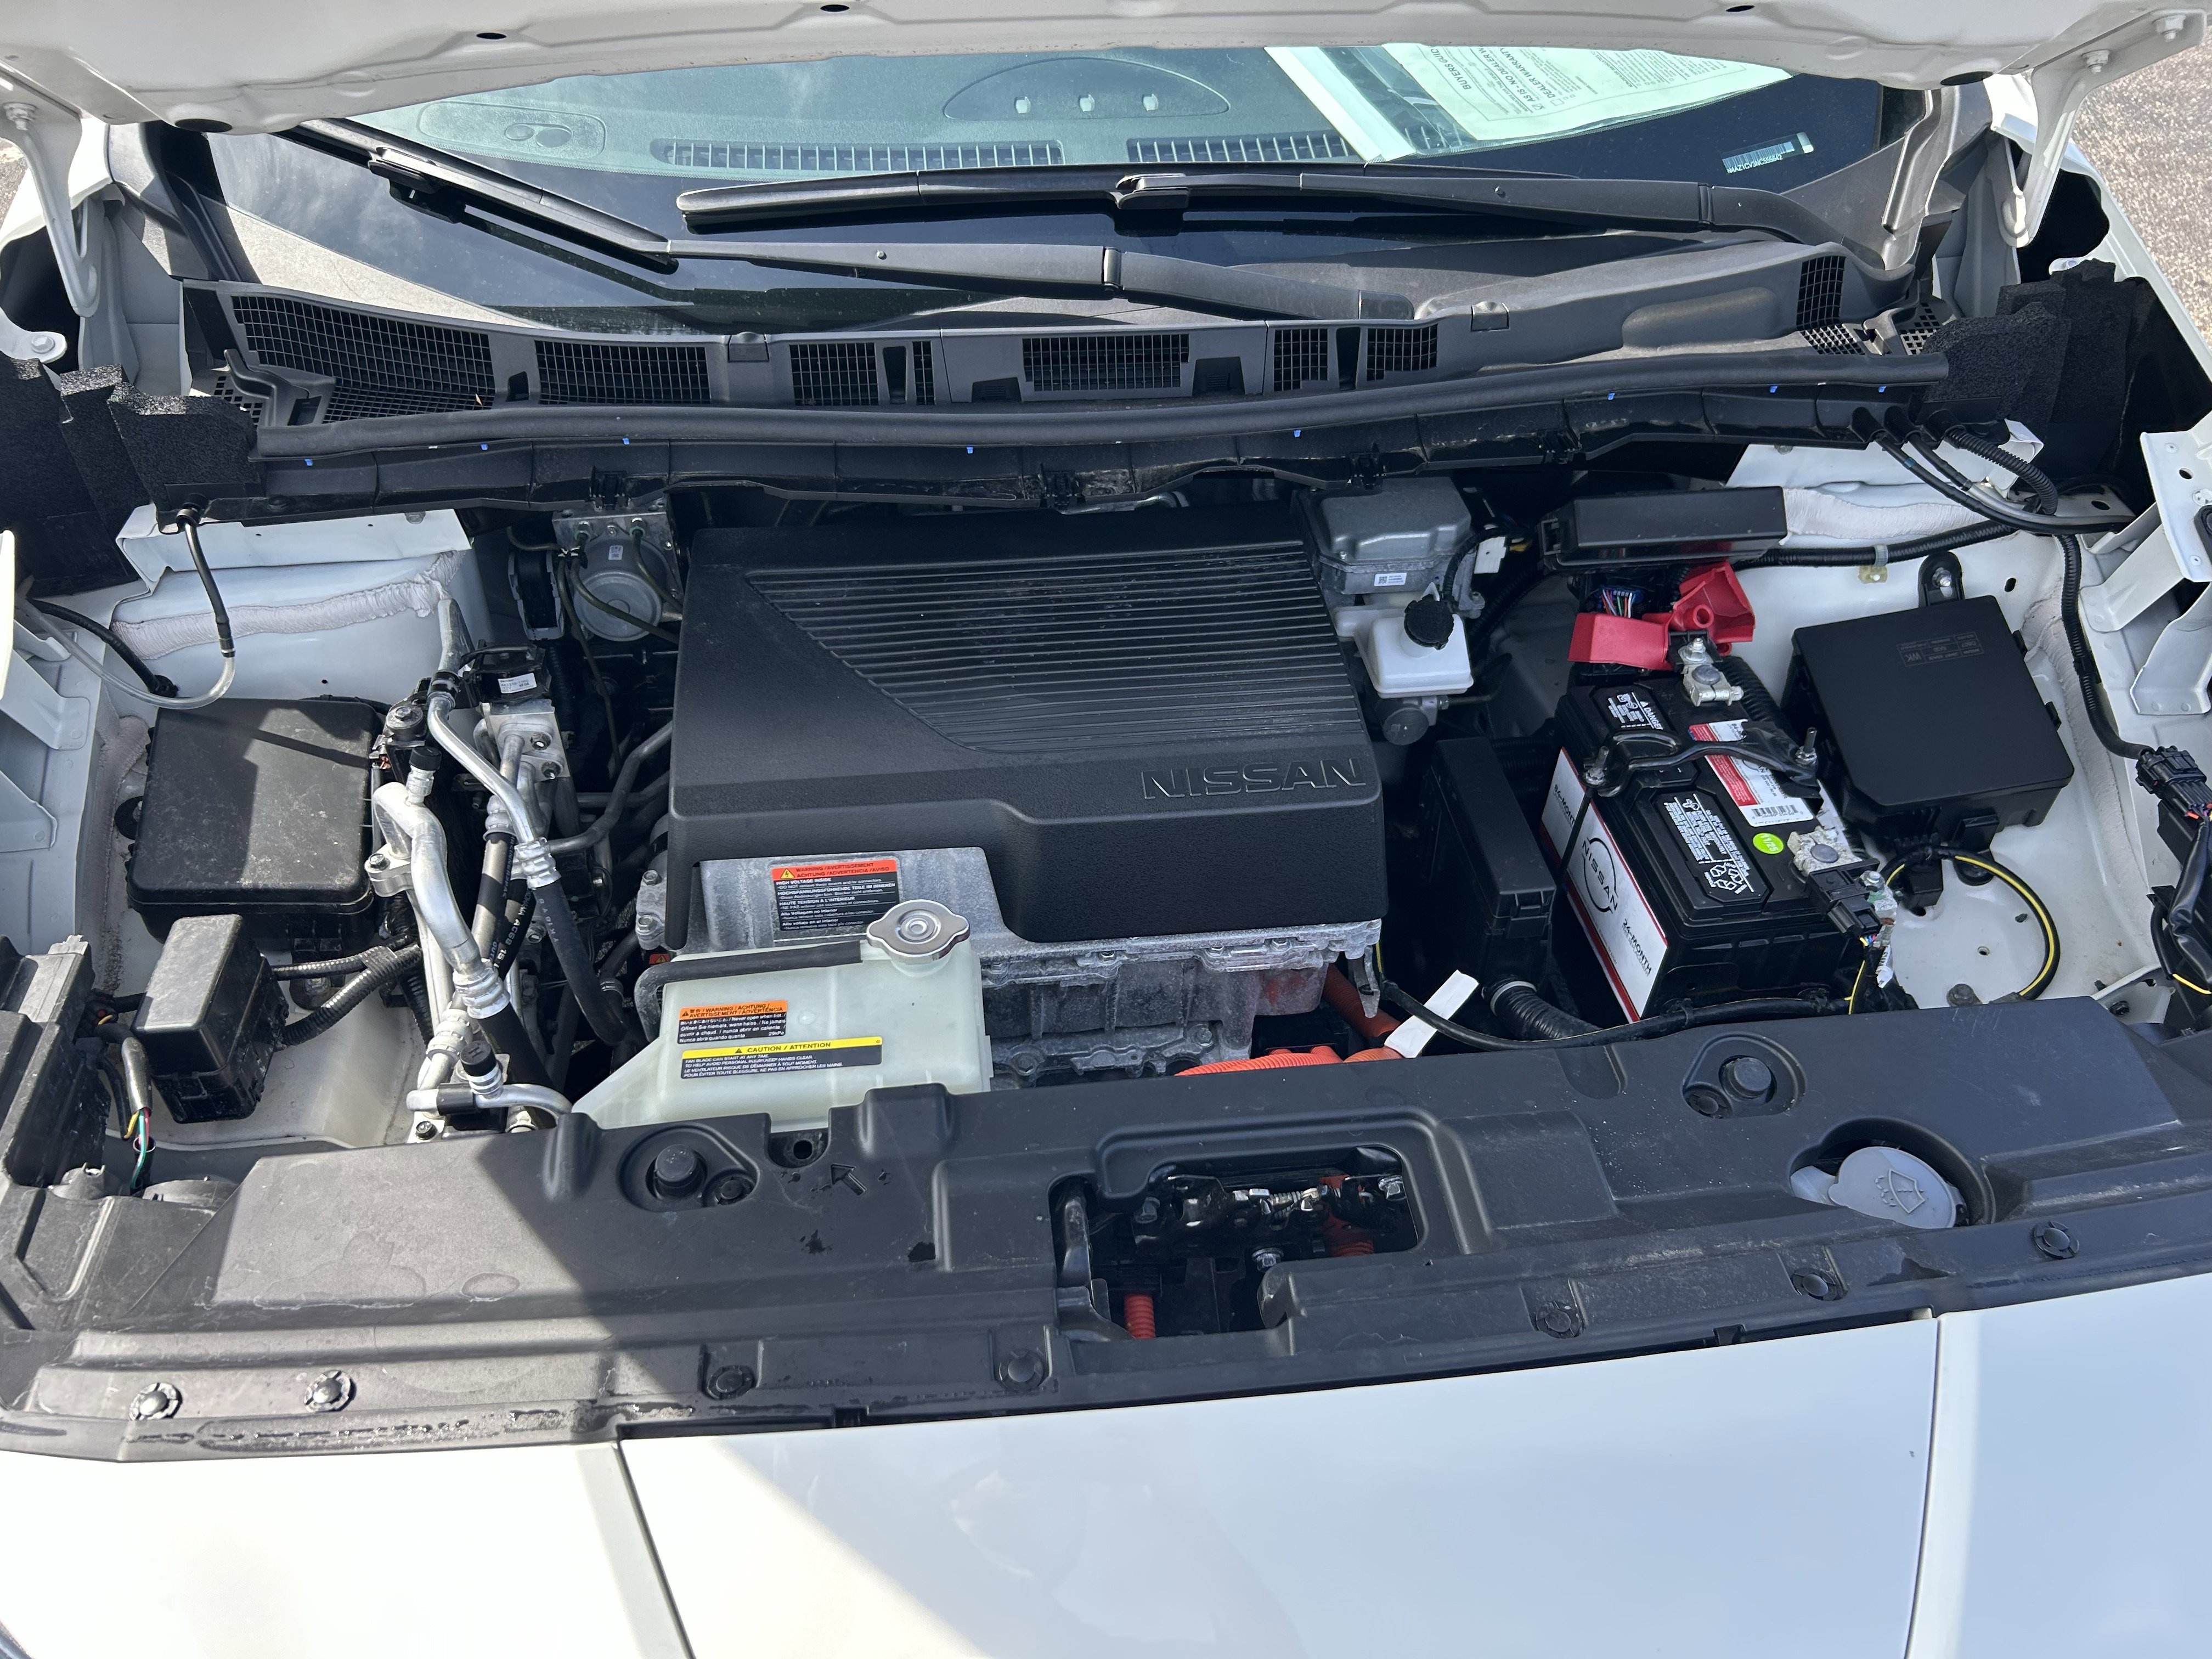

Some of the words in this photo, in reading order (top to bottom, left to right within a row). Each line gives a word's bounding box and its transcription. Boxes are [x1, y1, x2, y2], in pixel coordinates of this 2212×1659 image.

[1431, 48, 1448, 63] GUID
[1483, 54, 1508, 76] DEALER
[1500, 48, 1533, 78] WARRANTY
[1444, 64, 1472, 90] BUYERS
[1505, 75, 1517, 85] NO
[1528, 77, 1556, 98] DEALER
[1517, 87, 1526, 95] IS
[1644, 707, 1663, 730] DANGE
[1141, 758, 1366, 799] NISSAN
[1554, 783, 1575, 827] 84-MONT
[1759, 833, 1778, 851] 11/25
[1582, 839, 1618, 912] NISSAN
[1623, 917, 1652, 975] 24-MONTH
[789, 1041, 831, 1049] ATTENTION
